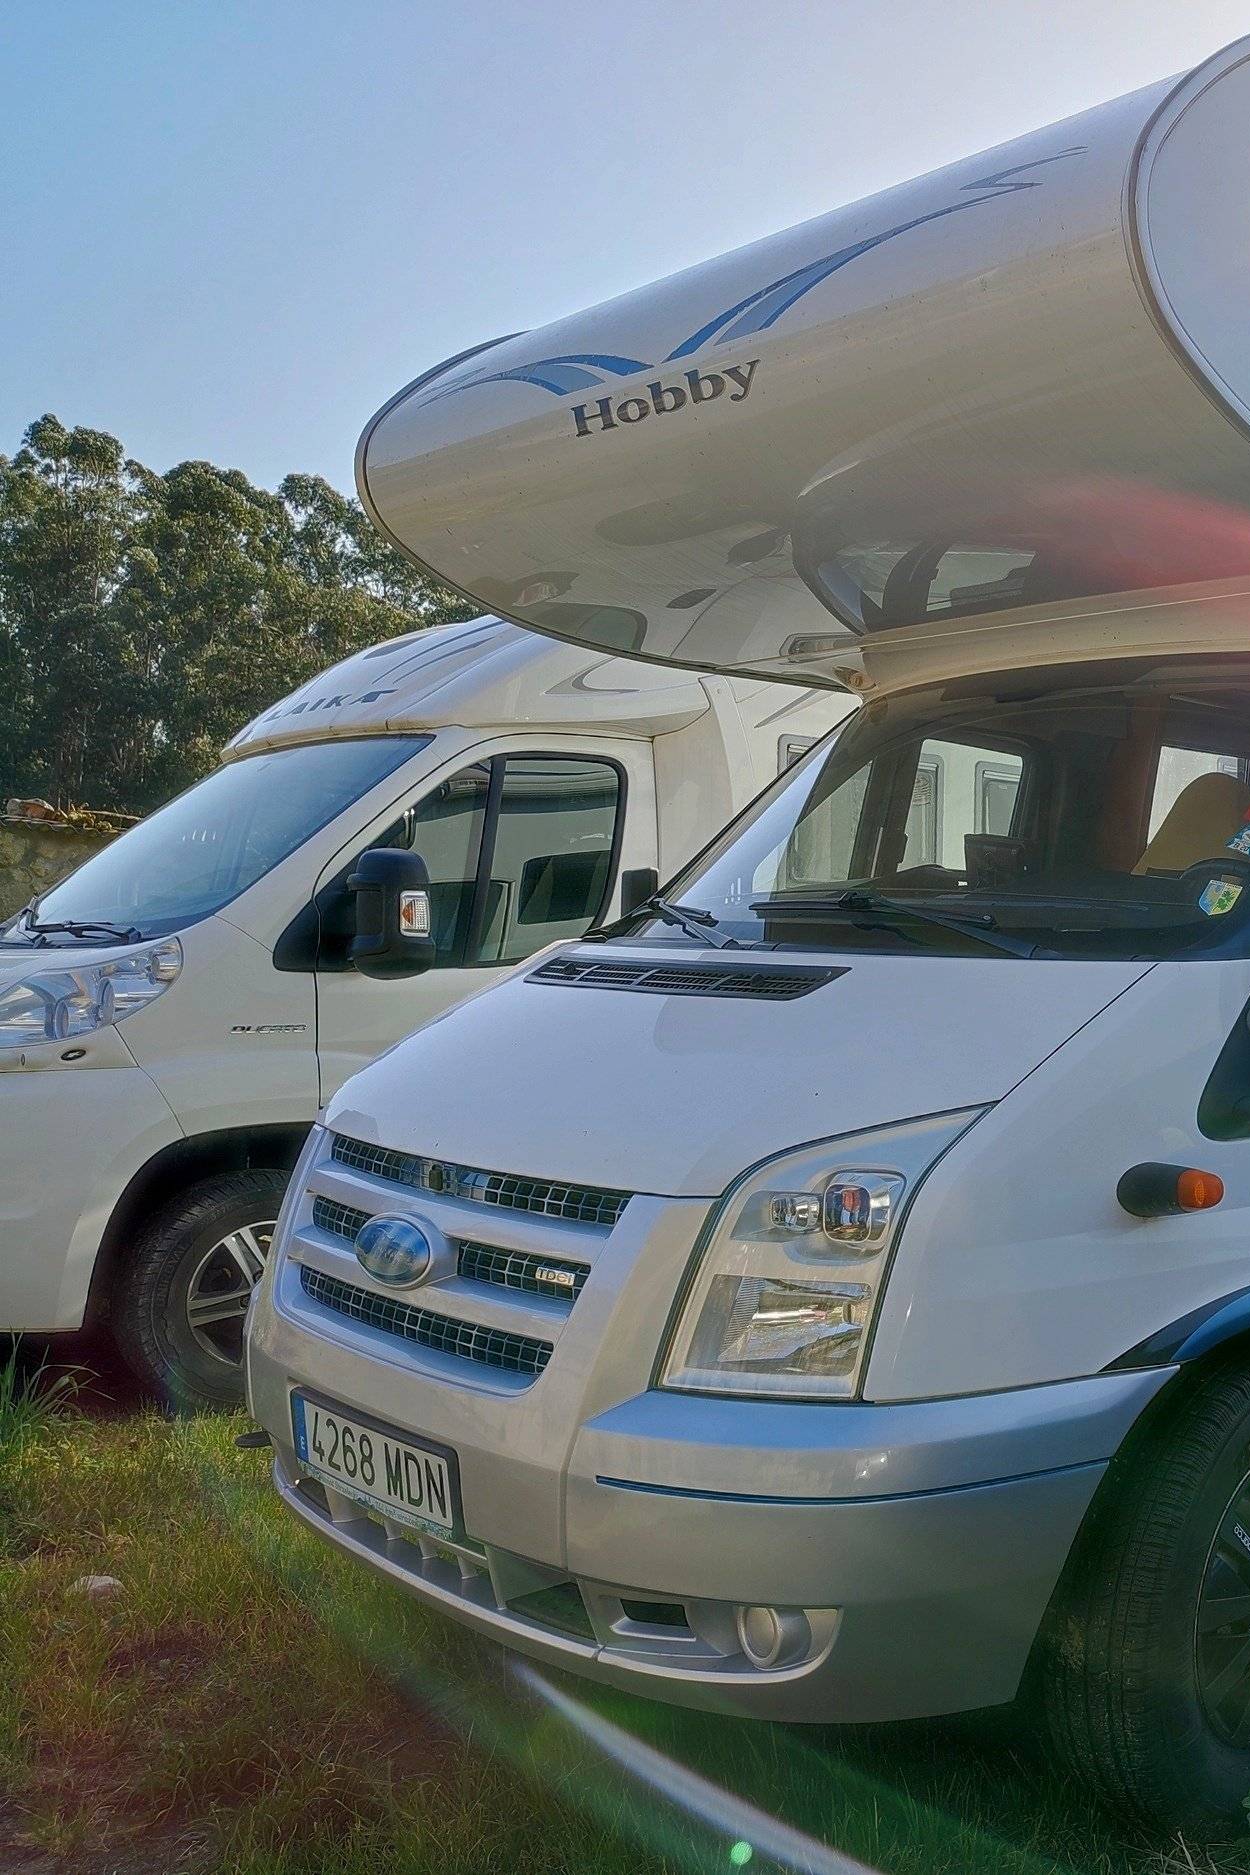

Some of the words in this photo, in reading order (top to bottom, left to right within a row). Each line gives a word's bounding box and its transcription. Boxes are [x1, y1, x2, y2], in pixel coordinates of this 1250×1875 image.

[570, 358, 761, 438] Hobby
[312, 1411, 376, 1487] 4268
[383, 1442, 447, 1518] MDN
